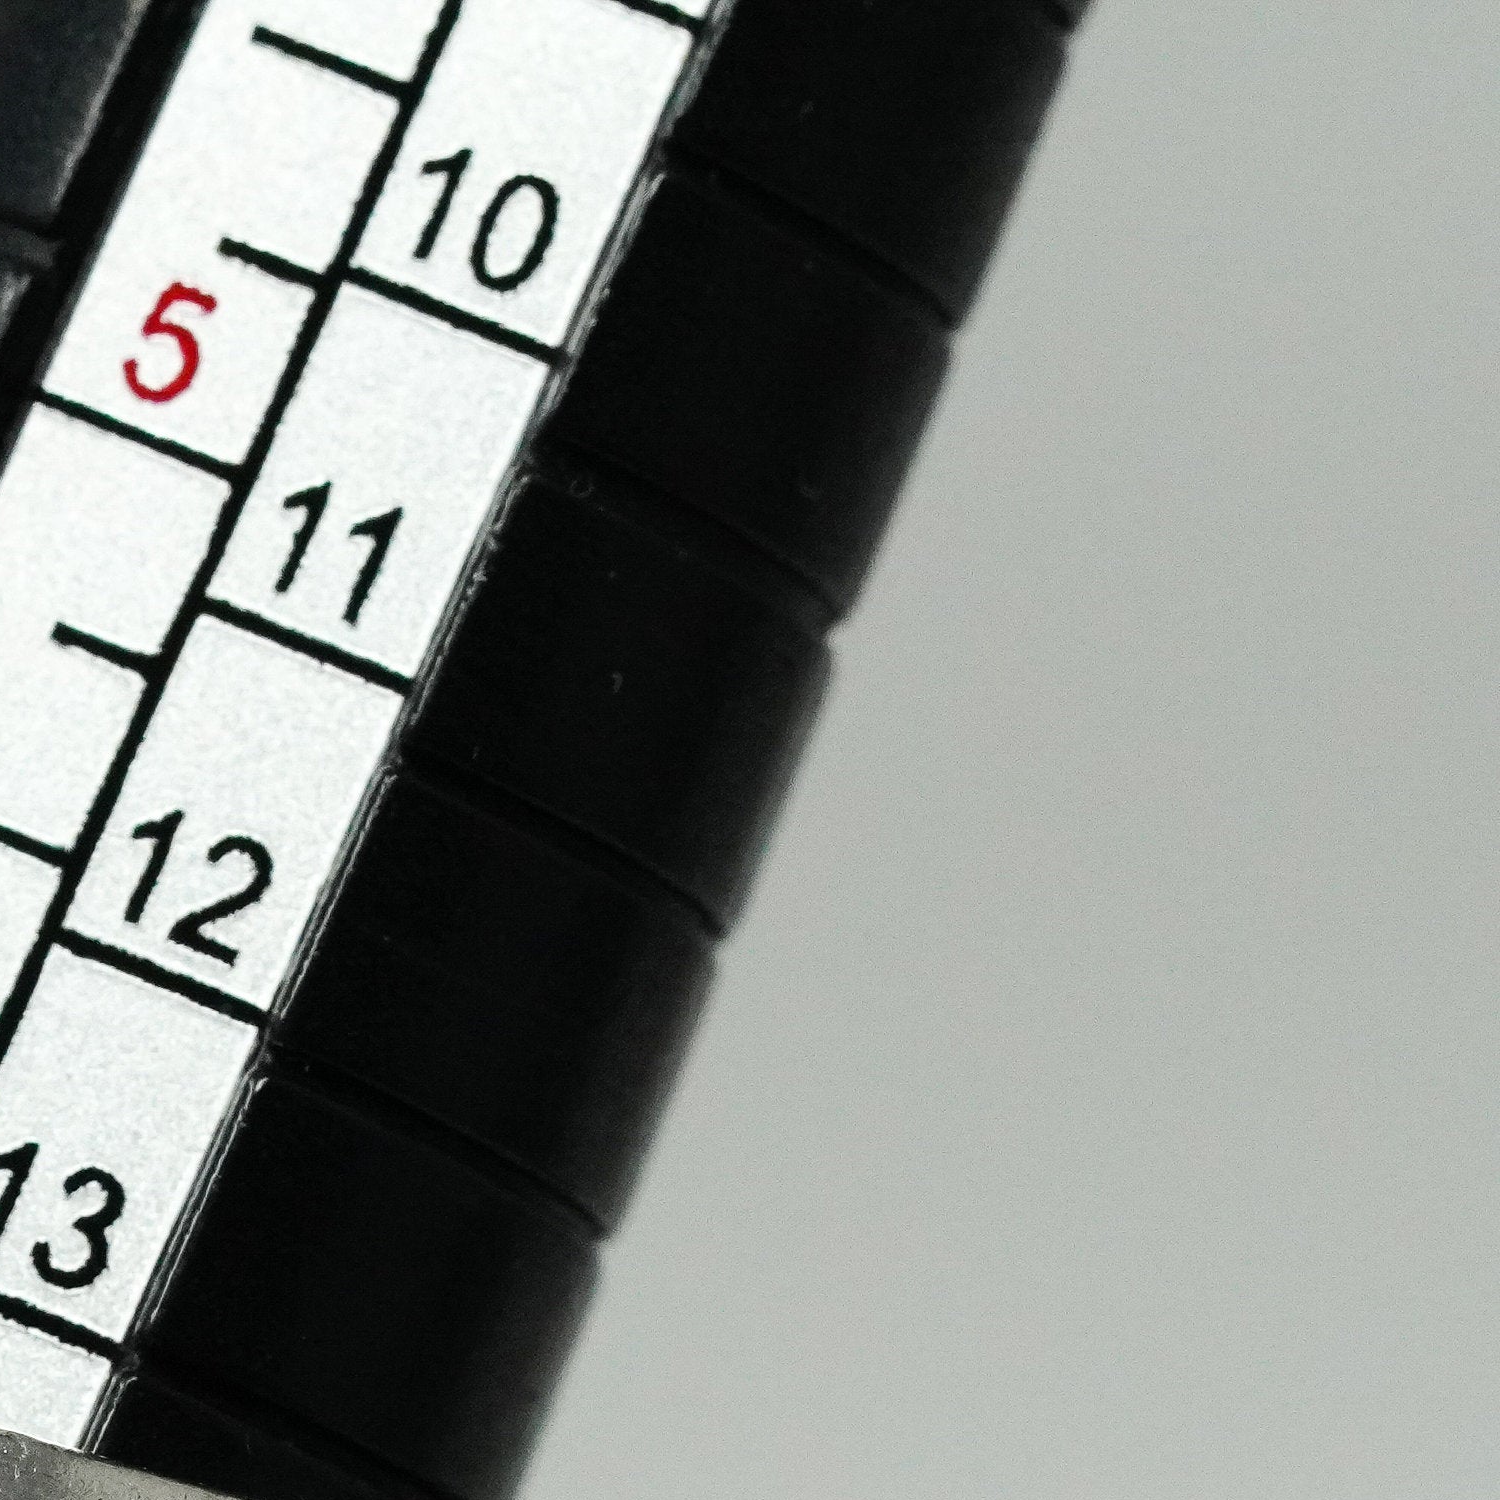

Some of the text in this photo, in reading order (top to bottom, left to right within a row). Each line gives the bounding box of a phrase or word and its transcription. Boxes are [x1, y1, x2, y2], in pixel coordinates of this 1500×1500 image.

[412, 147, 560, 294] 10
[121, 281, 218, 404] 5
[273, 480, 404, 626] 11
[123, 808, 275, 969] 12
